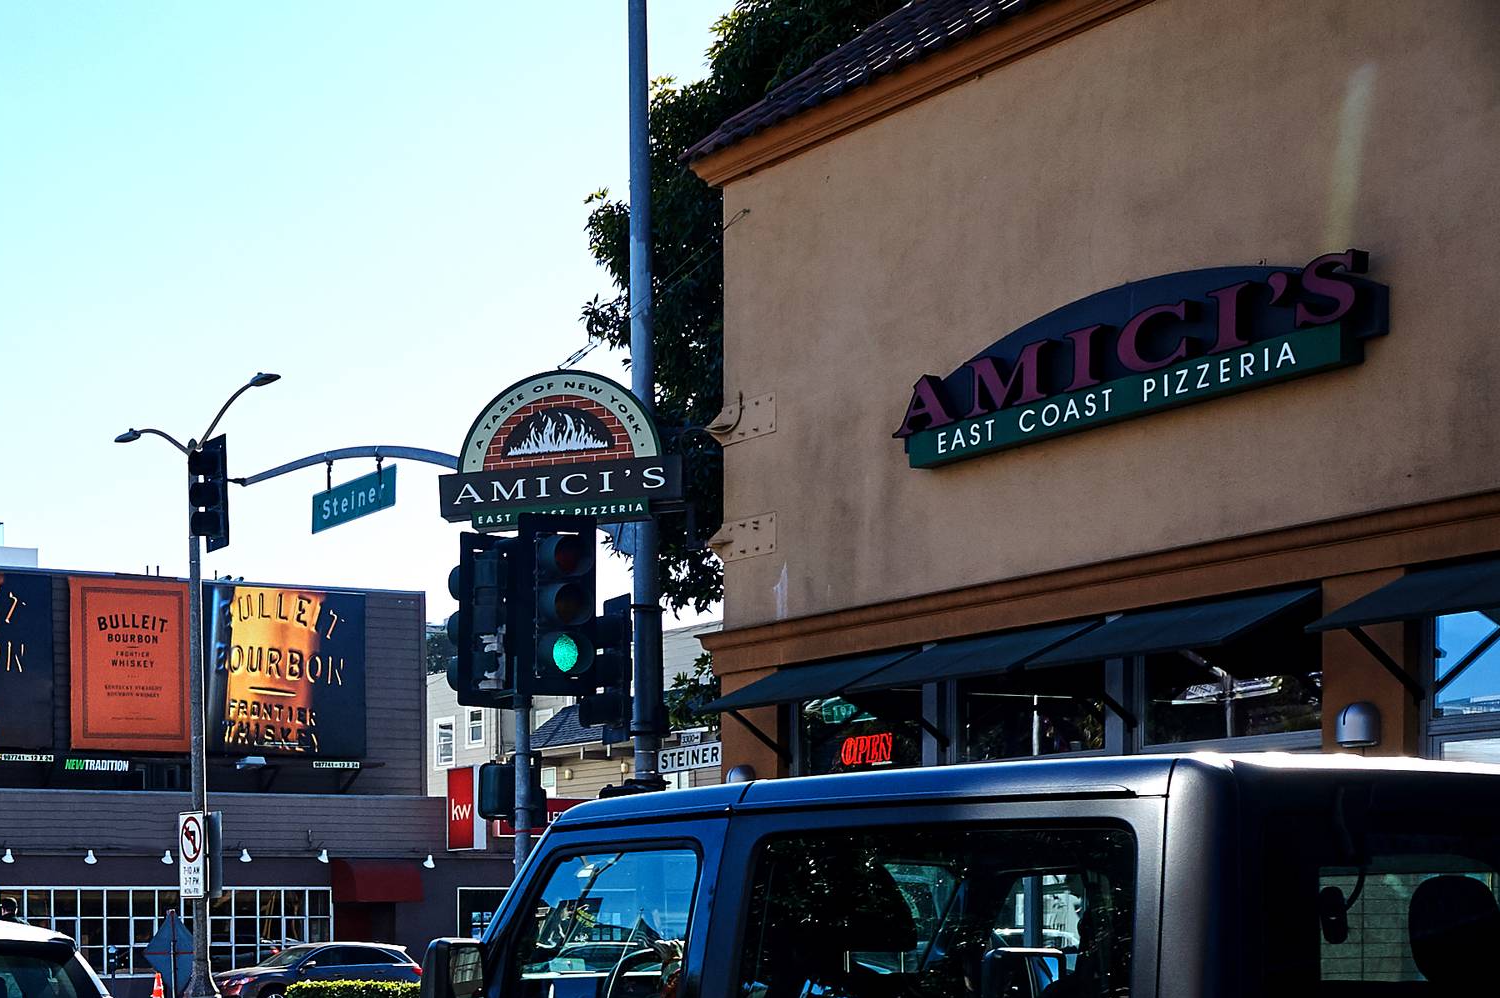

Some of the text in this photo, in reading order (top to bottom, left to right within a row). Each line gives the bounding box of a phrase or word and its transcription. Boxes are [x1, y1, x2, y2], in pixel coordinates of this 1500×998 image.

[894, 249, 1366, 438] AMICI'S
[937, 341, 1297, 454] EAST COAST PIZZERIA
[476, 381, 642, 450] A TASTE OF NEW YORK
[453, 466, 666, 505] AMICI'S
[478, 513, 511, 524] EAST
[574, 503, 643, 516] PIZZERIA
[97, 613, 168, 634] BULLEIT
[107, 633, 158, 644] BOURBON
[111, 659, 155, 668] WHISKEY
[115, 650, 150, 658] FRONTIER
[228, 698, 316, 726] FRONTIER
[661, 746, 719, 769] STEINER
[841, 733, 893, 766] OPEN
[451, 798, 472, 821] kw
